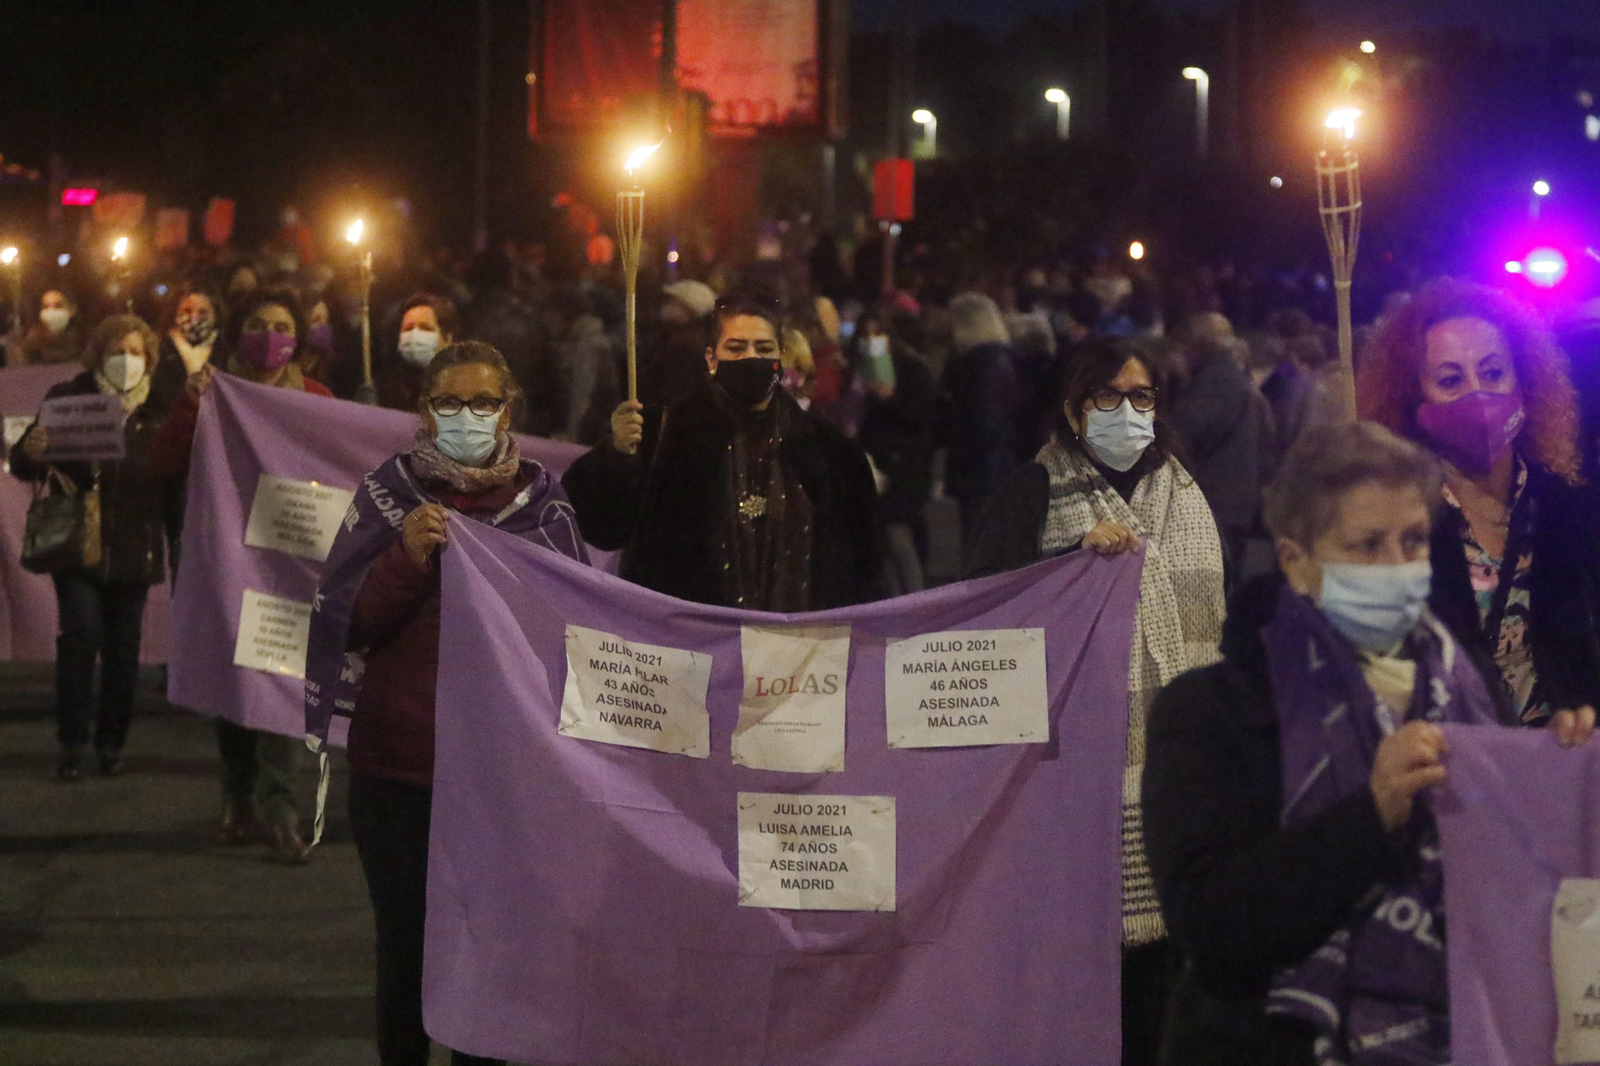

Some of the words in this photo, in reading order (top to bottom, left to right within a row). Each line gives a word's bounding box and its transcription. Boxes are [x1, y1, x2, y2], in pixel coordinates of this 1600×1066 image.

[922, 641, 963, 653] JULIO
[966, 640, 996, 651] 2021
[599, 641, 633, 658] JULIO
[635, 652, 663, 667] 2021
[589, 658, 631, 676] MARÍA
[902, 661, 948, 675] MARÍA
[951, 658, 1018, 673] ÁNGELES
[604, 679, 618, 690] 43
[621, 680, 655, 698] AÑOS
[754, 673, 839, 697] LOLAS
[930, 680, 946, 691] 46
[949, 677, 988, 691] AÑOS
[596, 693, 668, 715] ASESINADA
[919, 696, 1000, 711] ASESINADA
[599, 711, 663, 732] NAVARRA
[927, 714, 989, 728] MÁLAGA
[773, 804, 813, 816] JULIO
[816, 804, 847, 816] 2021
[758, 823, 797, 835] LUISA
[800, 825, 853, 837] AMELIA
[780, 841, 795, 853] 74
[798, 840, 838, 854] AÑOS
[769, 859, 849, 872] ASESINADA
[780, 878, 834, 890] MADRID
